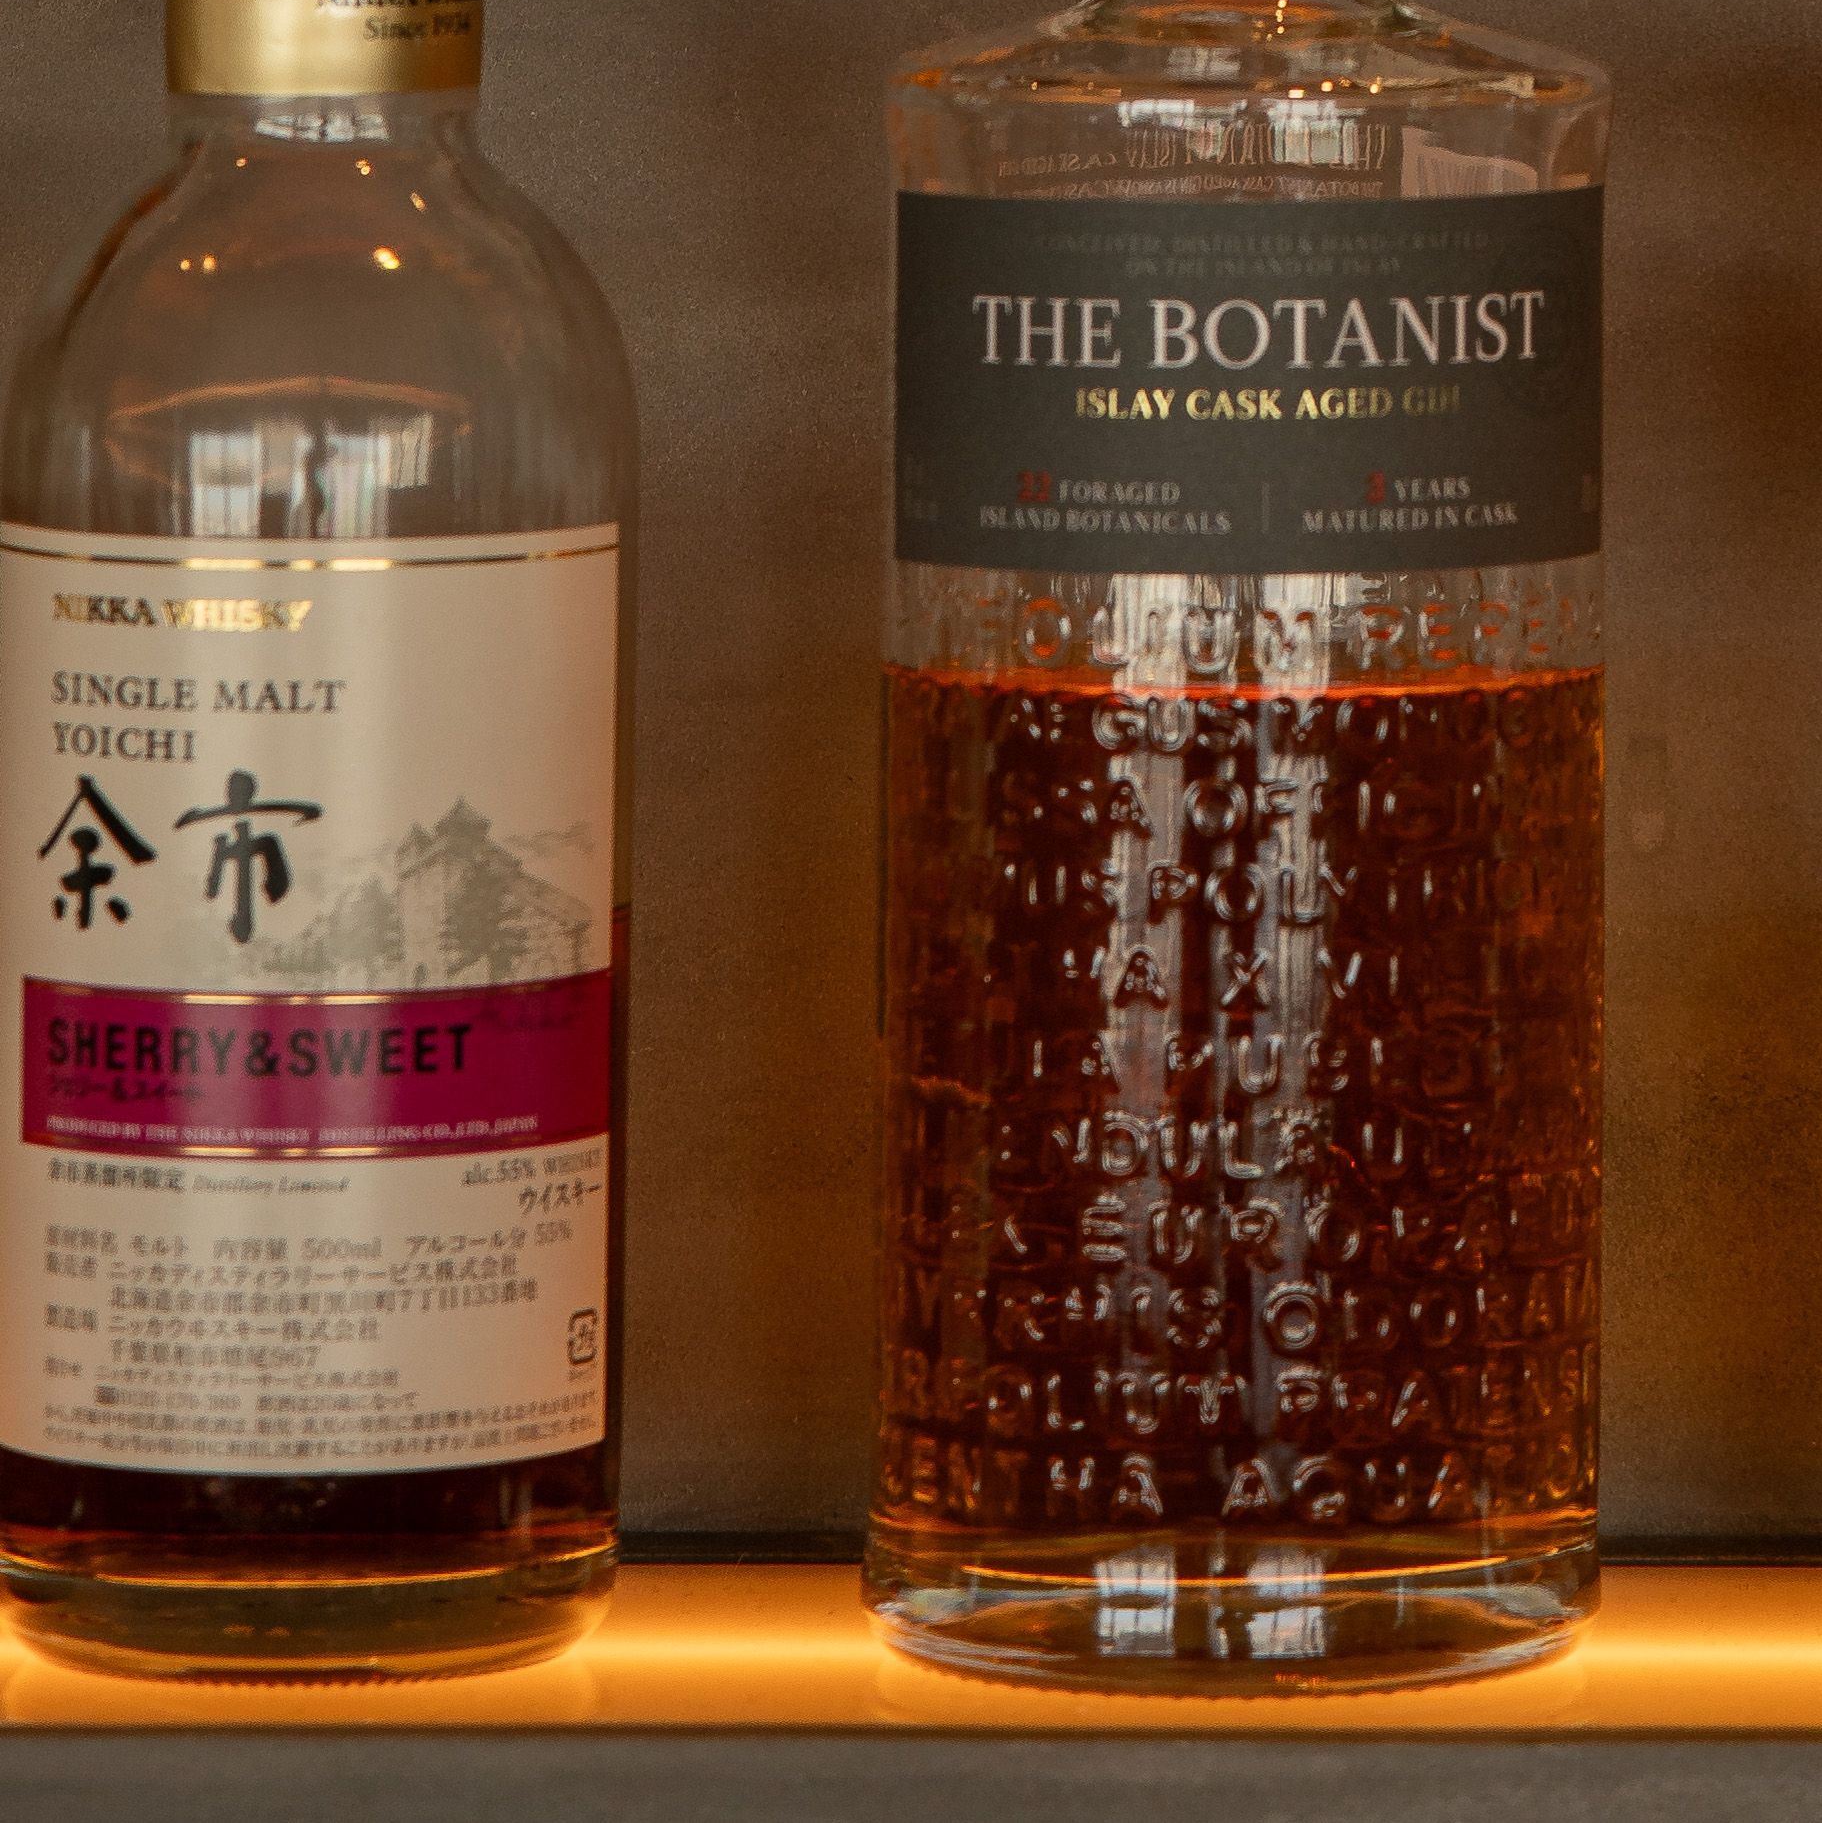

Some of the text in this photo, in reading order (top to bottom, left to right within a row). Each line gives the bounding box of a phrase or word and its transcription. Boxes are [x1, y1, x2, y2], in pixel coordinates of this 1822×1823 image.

[972, 291, 1545, 370] THE BOTANIST
[1076, 388, 1175, 421] ISLAY
[1185, 388, 1282, 421] CASK
[1295, 386, 1393, 421] AGED
[54, 592, 313, 632] NIKKA WHISKY
[51, 670, 348, 714] SINGLE MALT
[53, 721, 198, 763] YOICHI
[37, 770, 324, 945] 余市
[48, 1018, 472, 1076] SHERRY&SWEET
